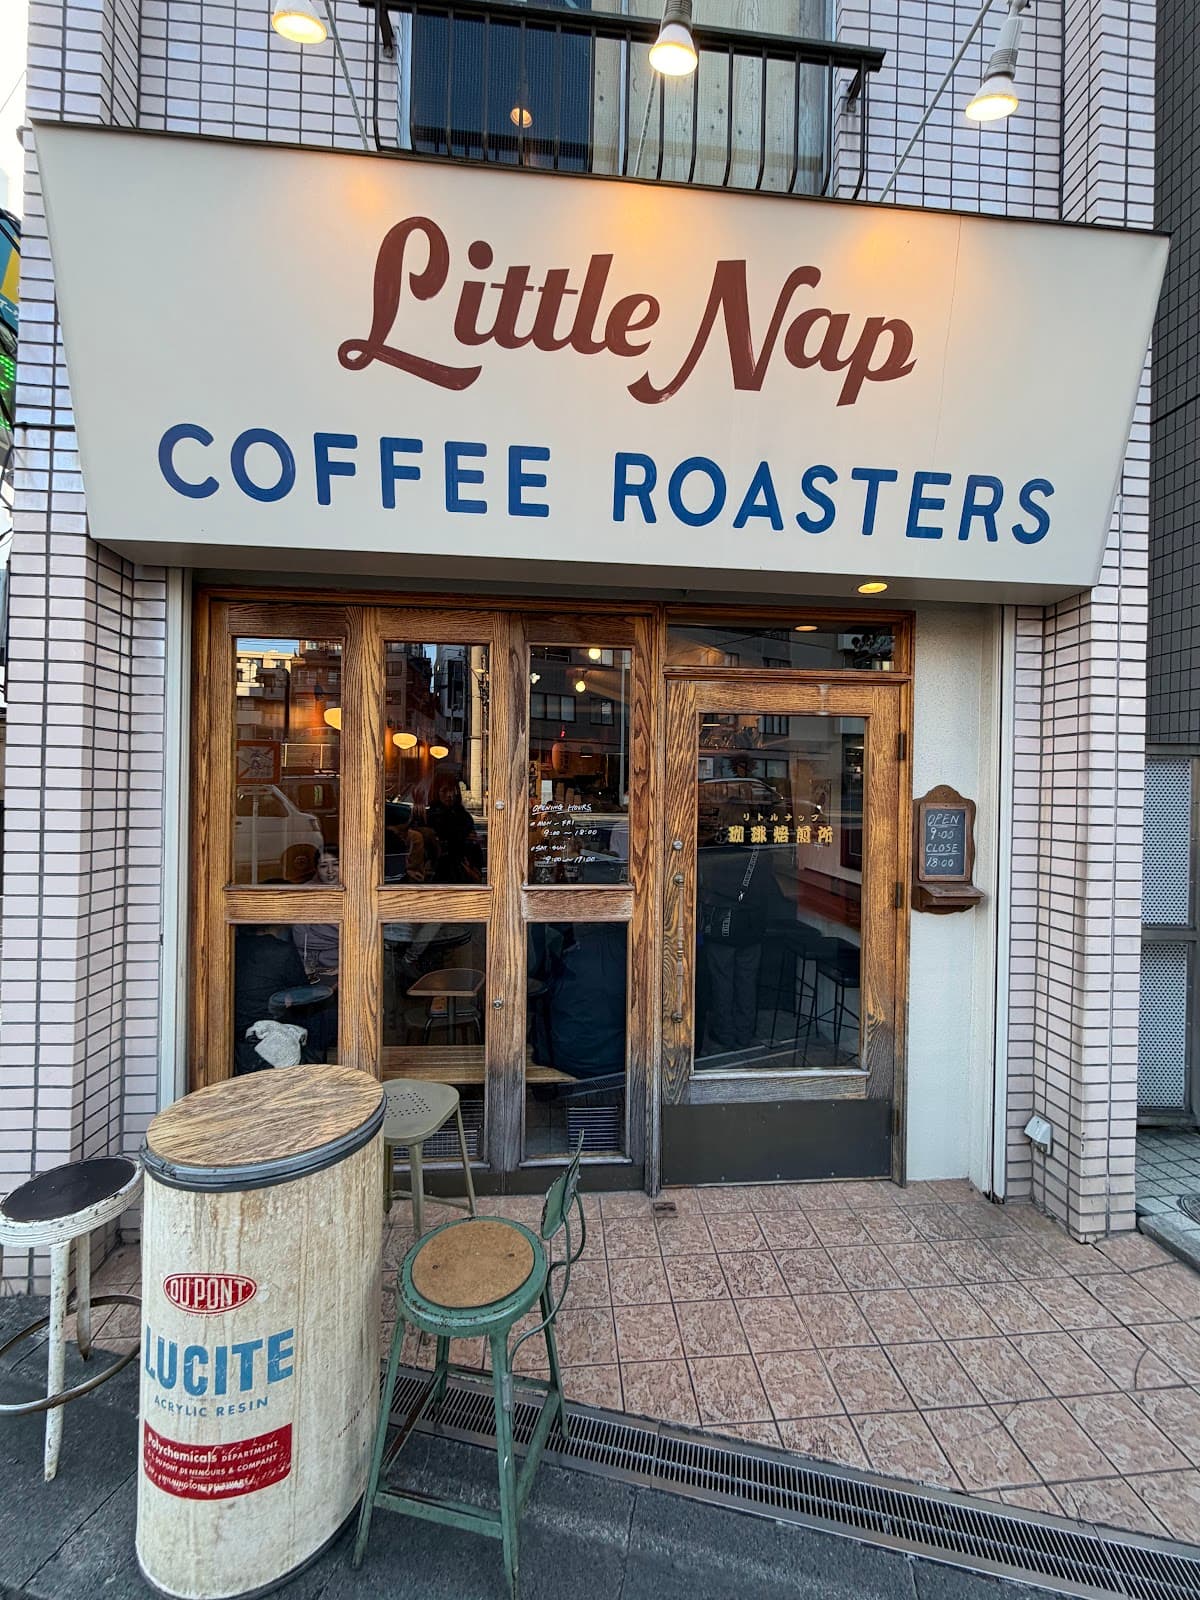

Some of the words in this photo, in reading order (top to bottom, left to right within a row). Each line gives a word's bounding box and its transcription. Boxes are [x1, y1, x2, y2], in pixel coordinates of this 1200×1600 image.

[337, 216, 661, 391] Little
[627, 259, 918, 407] Nap
[158, 423, 551, 519] COFFEE
[612, 451, 1055, 545] ROASTERS
[532, 803, 564, 813] OPENING
[567, 803, 592, 812] HOURS
[743, 812, 819, 822] リトルナップ
[561, 819, 575, 827] FRI
[927, 813, 960, 826] OPEN
[728, 825, 833, 844] 珈琲焙煎所
[930, 827, 954, 840] 9:00
[926, 843, 958, 853] CLOSE
[145, 1323, 294, 1397] LUCITE
[154, 1395, 207, 1417] ACRYLIC
[216, 1396, 269, 1417] RESIN
[148, 1432, 217, 1463] Polychemicals
[221, 1440, 279, 1462] DEPARTMENT
[188, 1468, 226, 1477] NEMOURS
[237, 1454, 278, 1472] COMPANY
